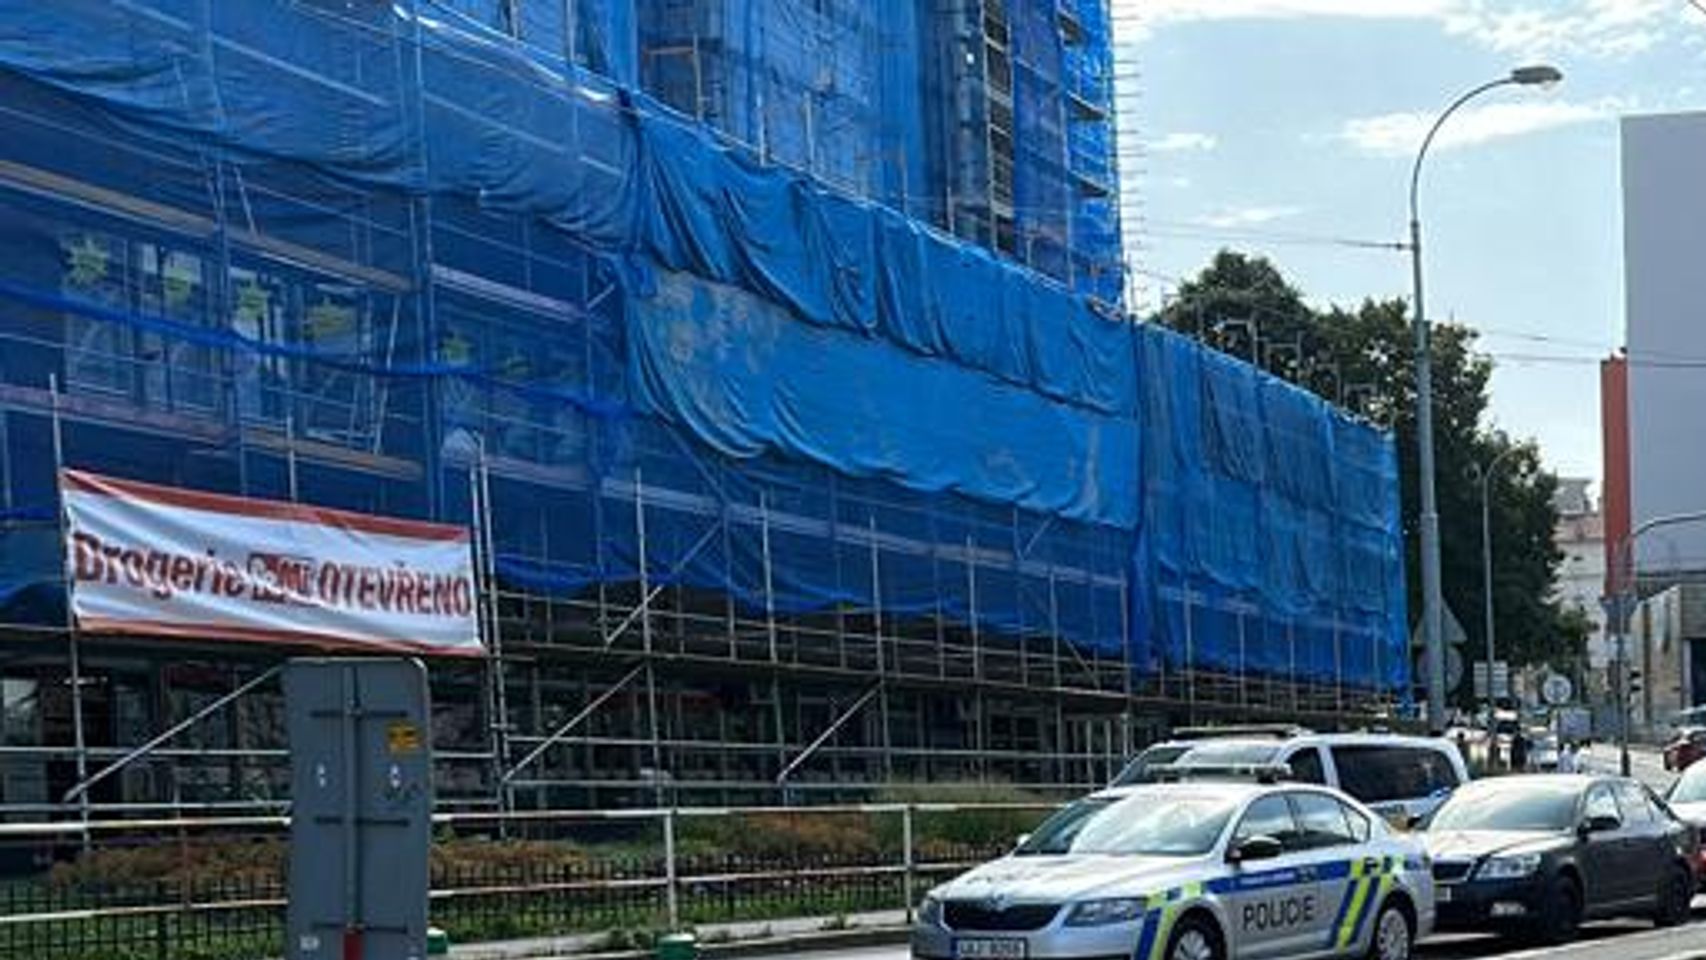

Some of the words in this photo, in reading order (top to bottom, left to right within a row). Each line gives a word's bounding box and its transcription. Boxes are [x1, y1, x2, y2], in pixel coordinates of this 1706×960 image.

[73, 531, 245, 600] Drogerie
[319, 560, 472, 617] OTEVŘENO
[1243, 894, 1315, 931] POLICIE
